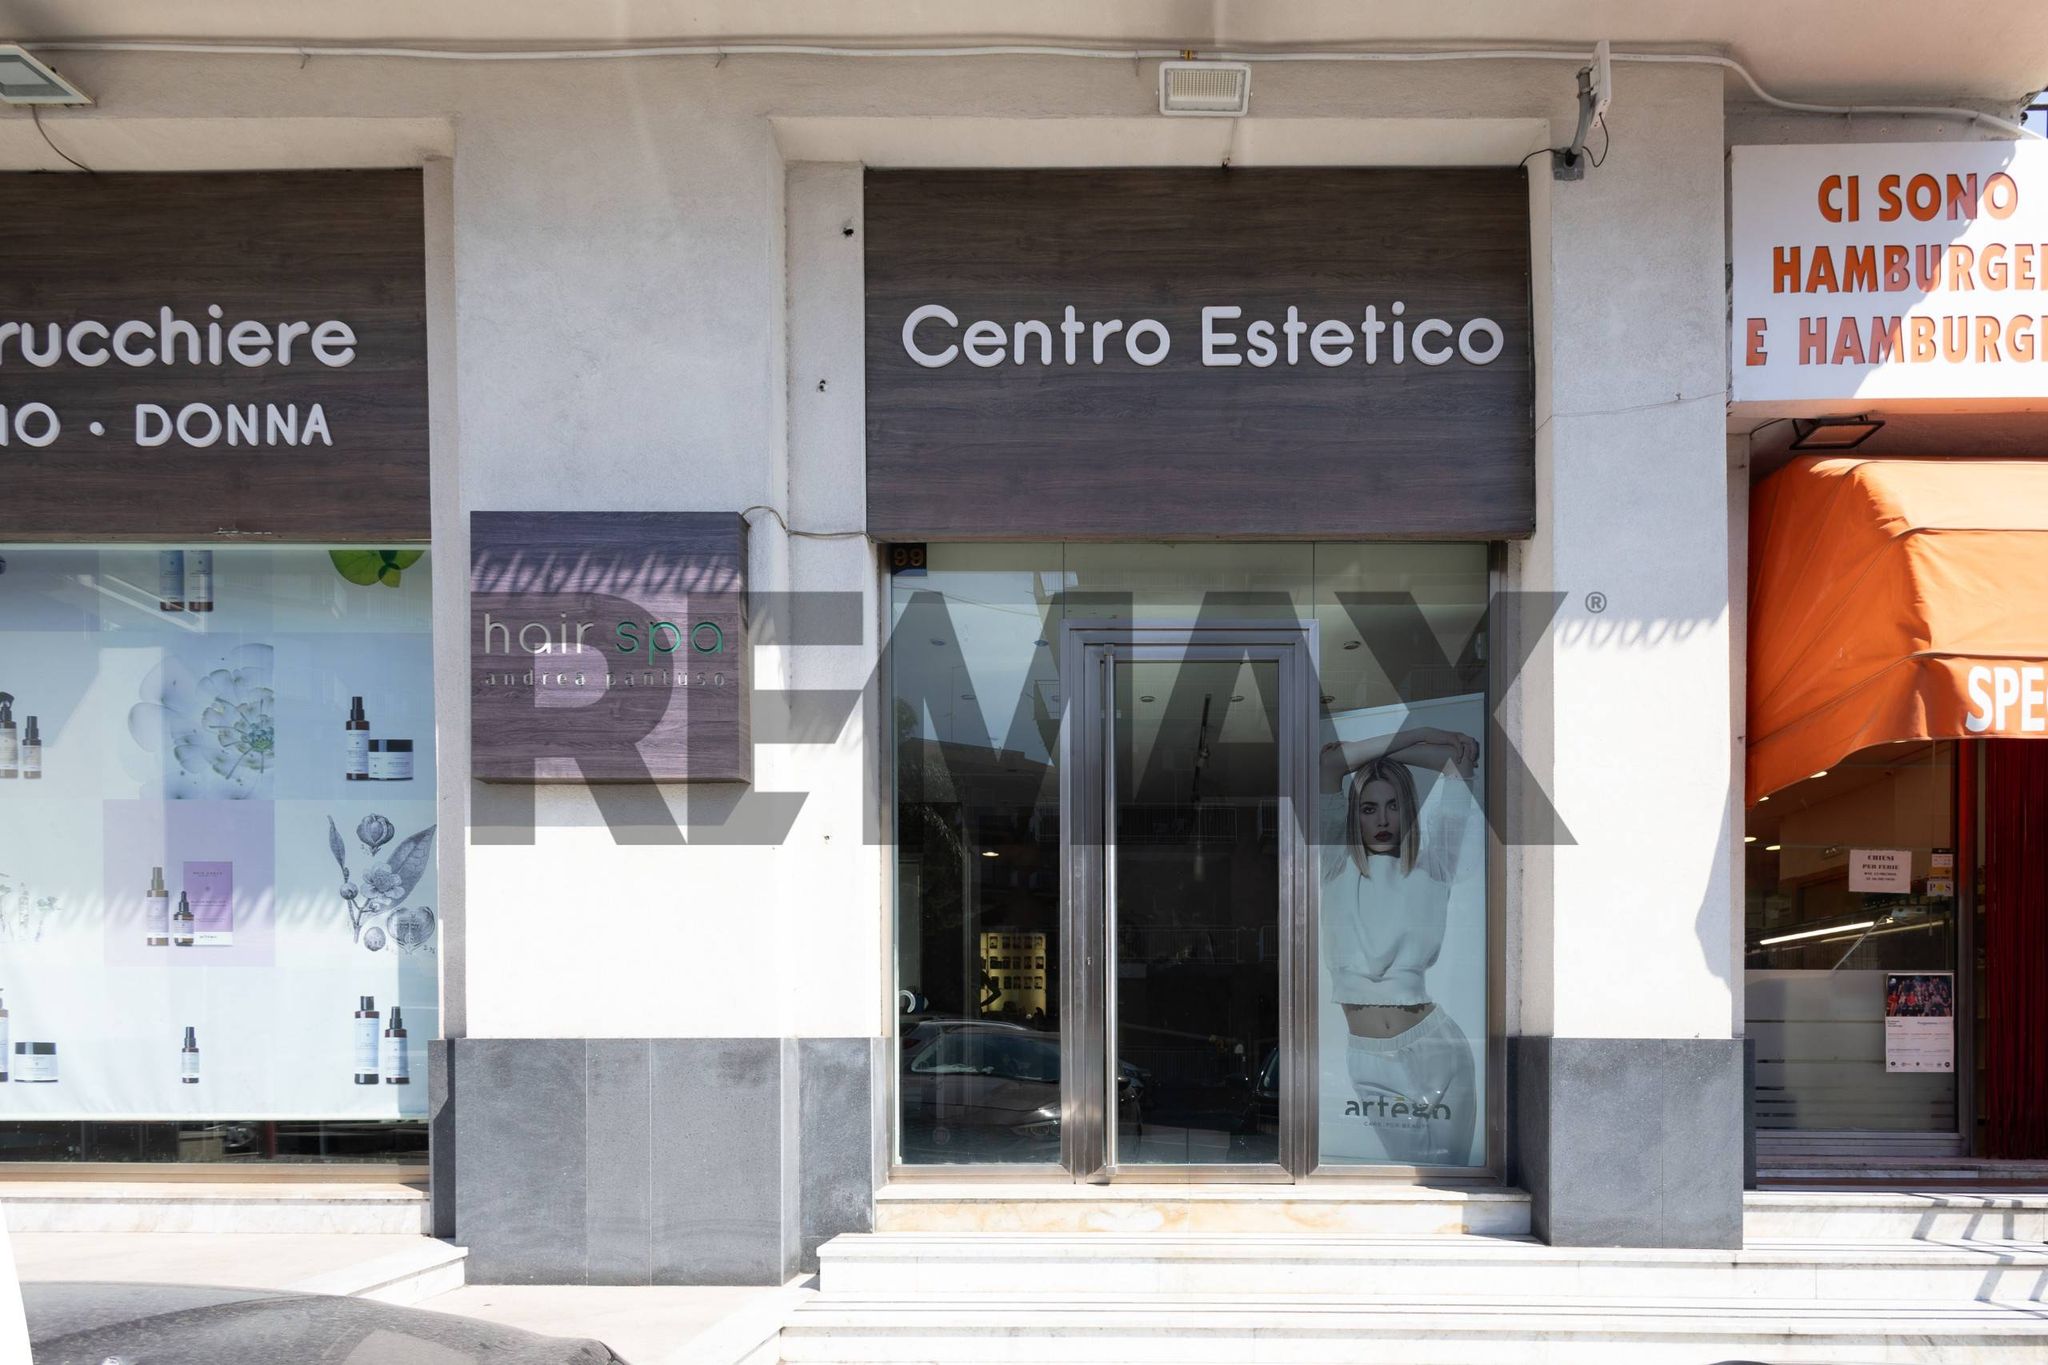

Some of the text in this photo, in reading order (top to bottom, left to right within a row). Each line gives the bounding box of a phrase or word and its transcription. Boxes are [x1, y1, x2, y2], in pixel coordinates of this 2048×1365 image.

[1818, 171, 2018, 223] CI SONO
[1772, 243, 2048, 293] HAMBURGE
[901, 301, 1505, 368] Centro Estetico
[1745, 314, 2048, 366] E HAMBURG
[135, 402, 334, 448] DONNA
[894, 547, 924, 566] 99
[484, 613, 724, 666] hair spa
[485, 667, 726, 690] andrea pantuso
[1965, 665, 2048, 732] SPE
